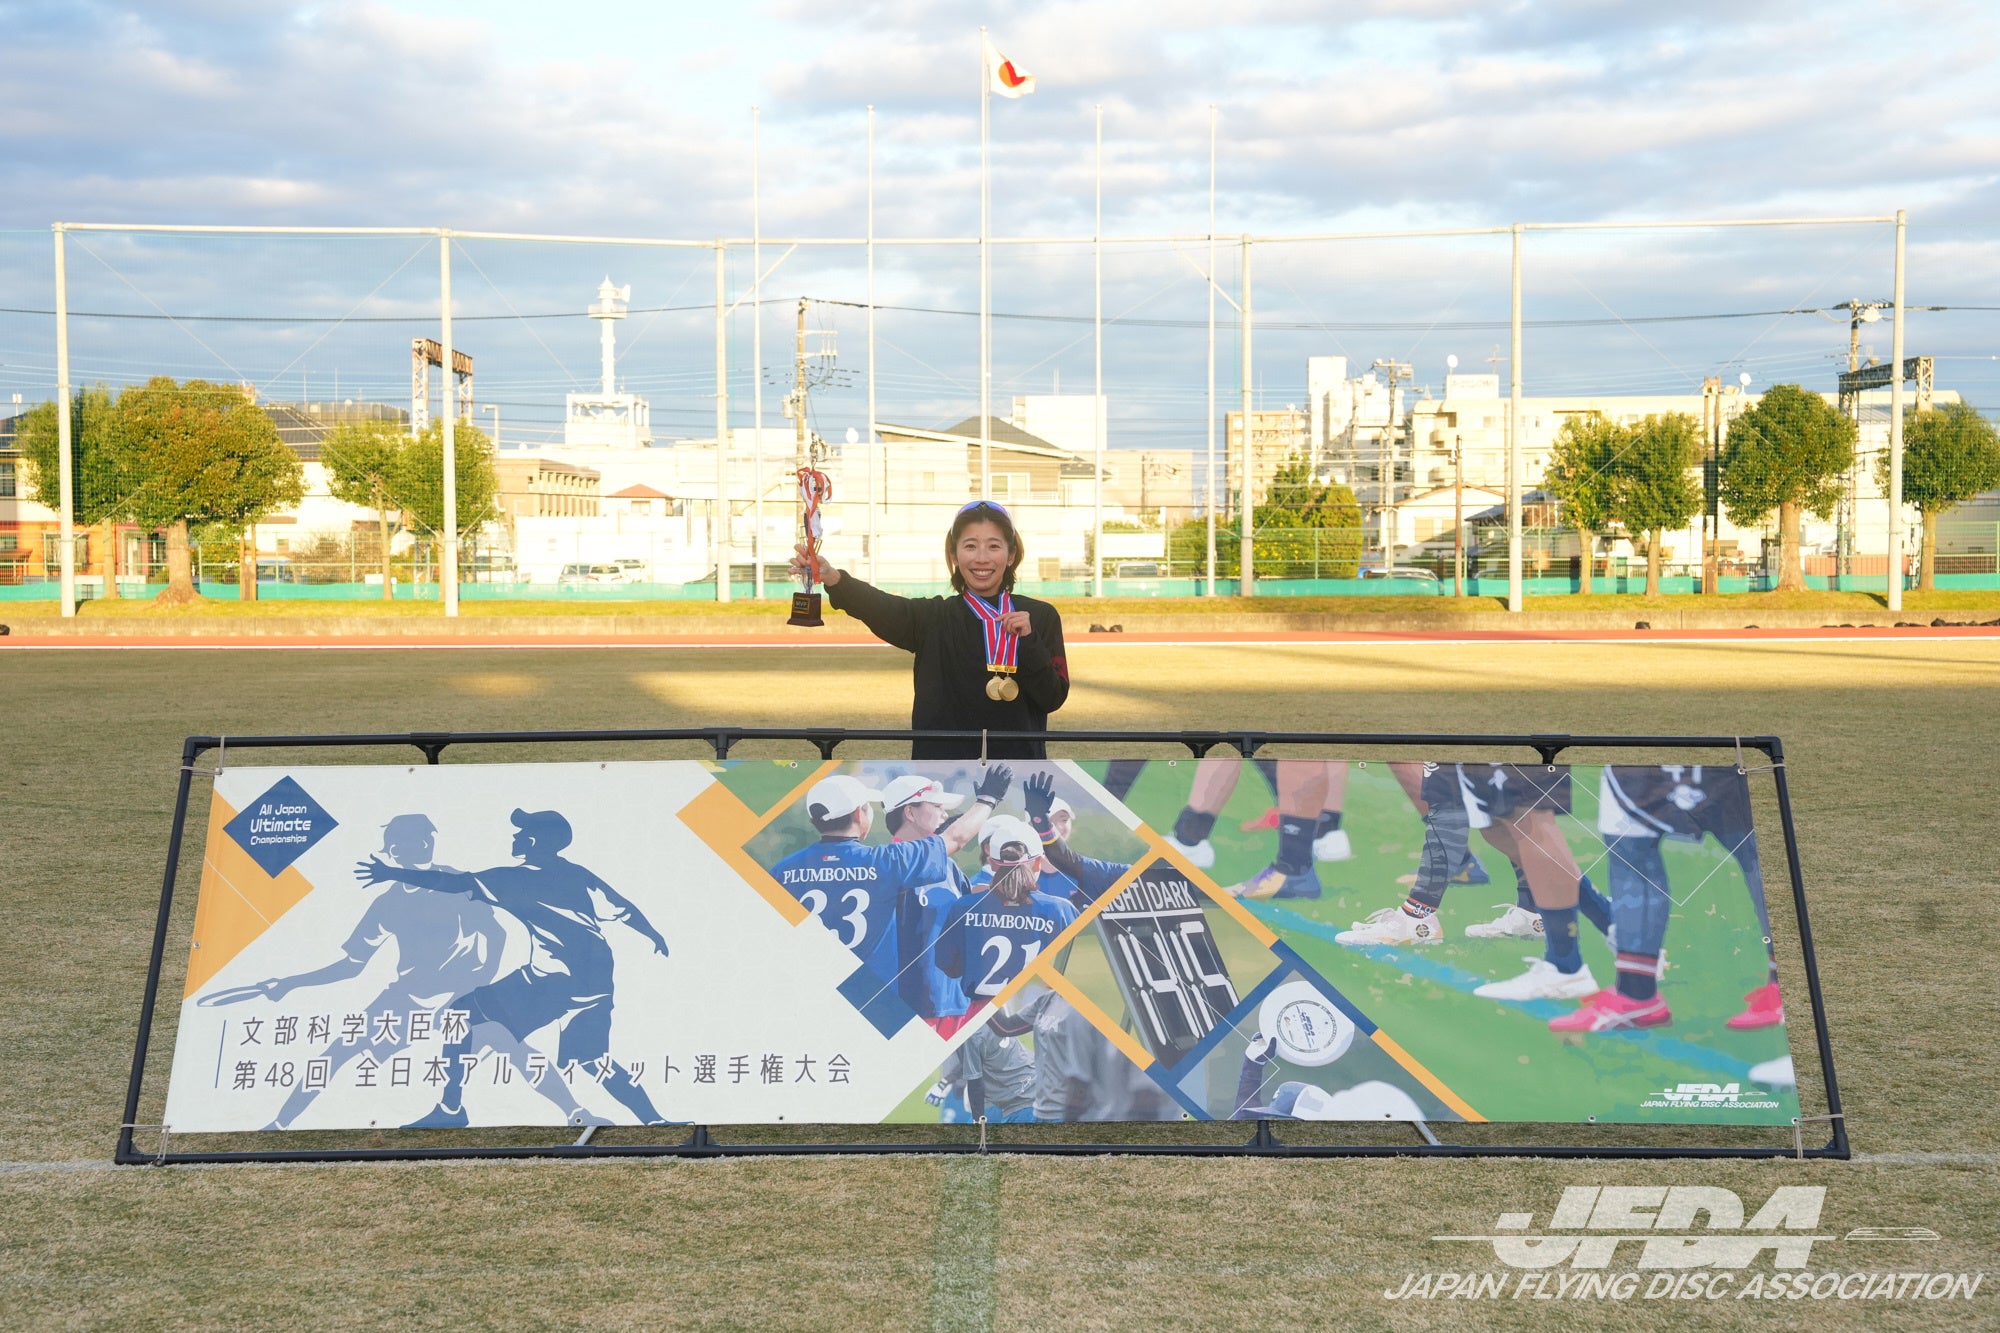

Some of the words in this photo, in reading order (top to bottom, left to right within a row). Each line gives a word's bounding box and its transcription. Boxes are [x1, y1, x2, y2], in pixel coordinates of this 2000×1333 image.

[259, 803, 273, 816] All
[275, 803, 307, 816] Japan
[250, 817, 312, 833] Ultimate
[250, 834, 308, 846] Championships
[783, 867, 877, 884] PLUMBONDS
[1146, 878, 1197, 910] DARK
[964, 912, 1055, 934] PLUMBONDS
[240, 1011, 468, 1046] 文部科学大臣杯
[232, 1059, 328, 1090] 第48回
[354, 1053, 852, 1088] 全日本アルティメット選手権大会
[1663, 1083, 1741, 1101] JFDA
